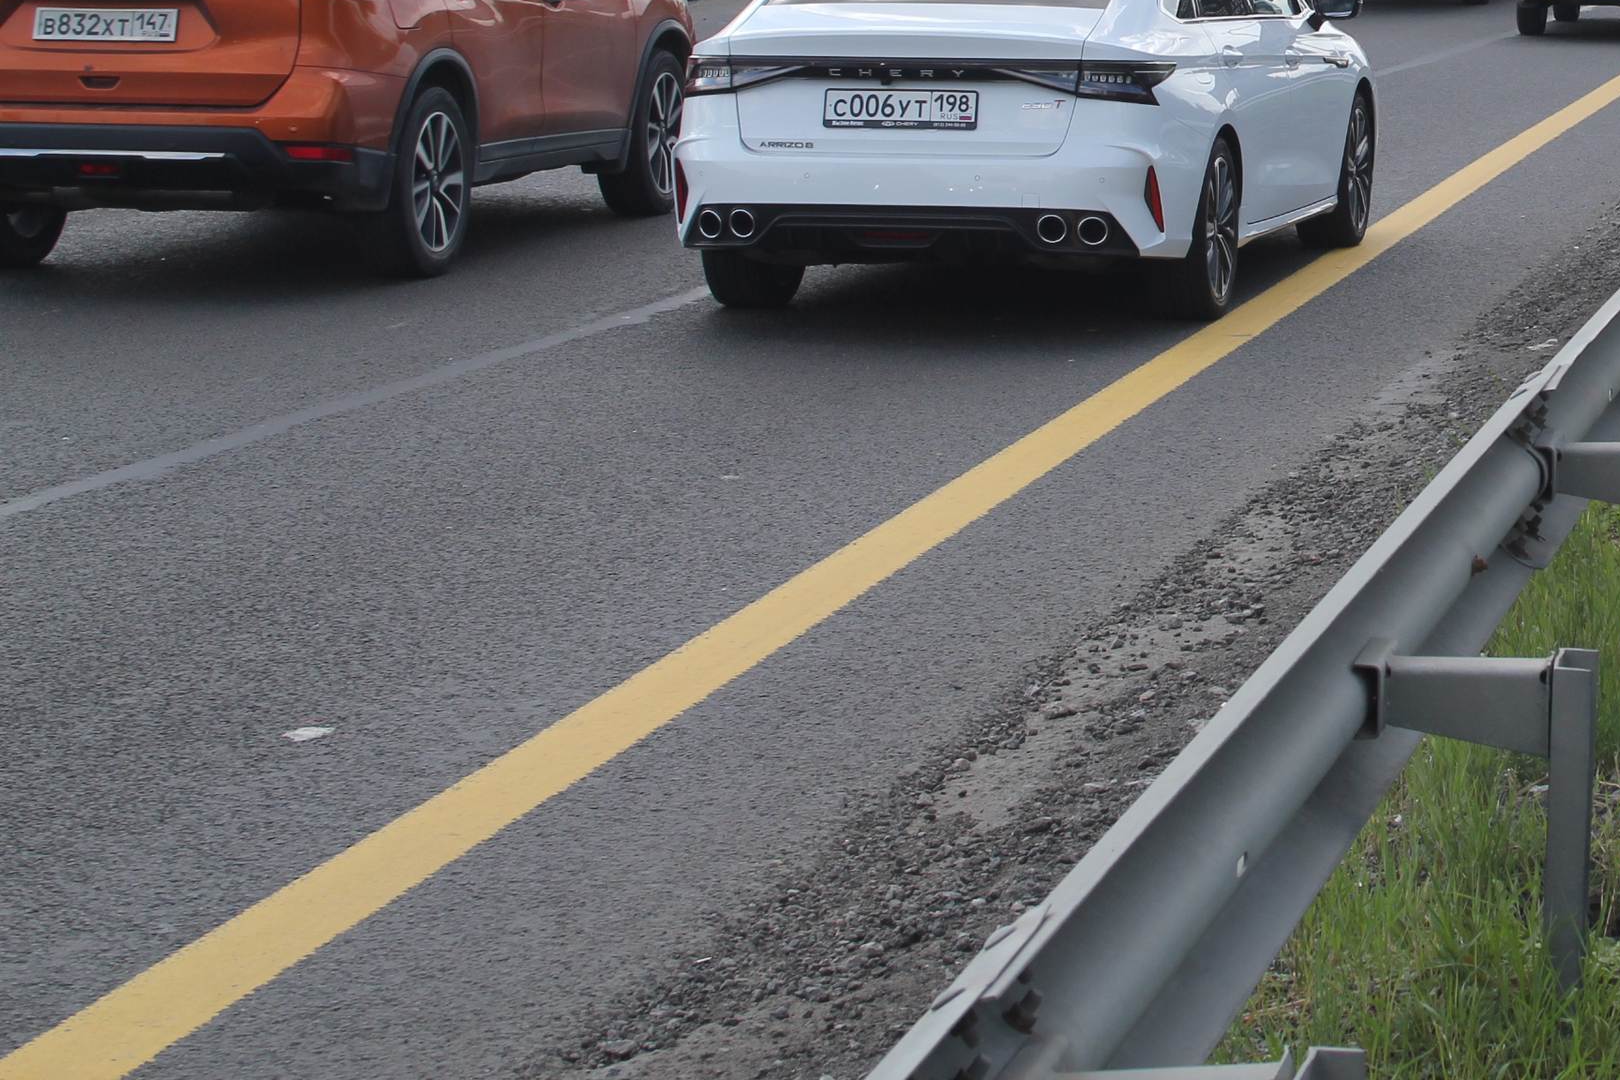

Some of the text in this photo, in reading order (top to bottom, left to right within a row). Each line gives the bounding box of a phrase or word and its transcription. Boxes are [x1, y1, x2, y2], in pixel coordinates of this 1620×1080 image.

[43, 13, 168, 37] В832ХТ 147
[829, 68, 964, 78] CHERY
[833, 93, 970, 118] С006УТ 198
[760, 141, 804, 149] ARRIZO
